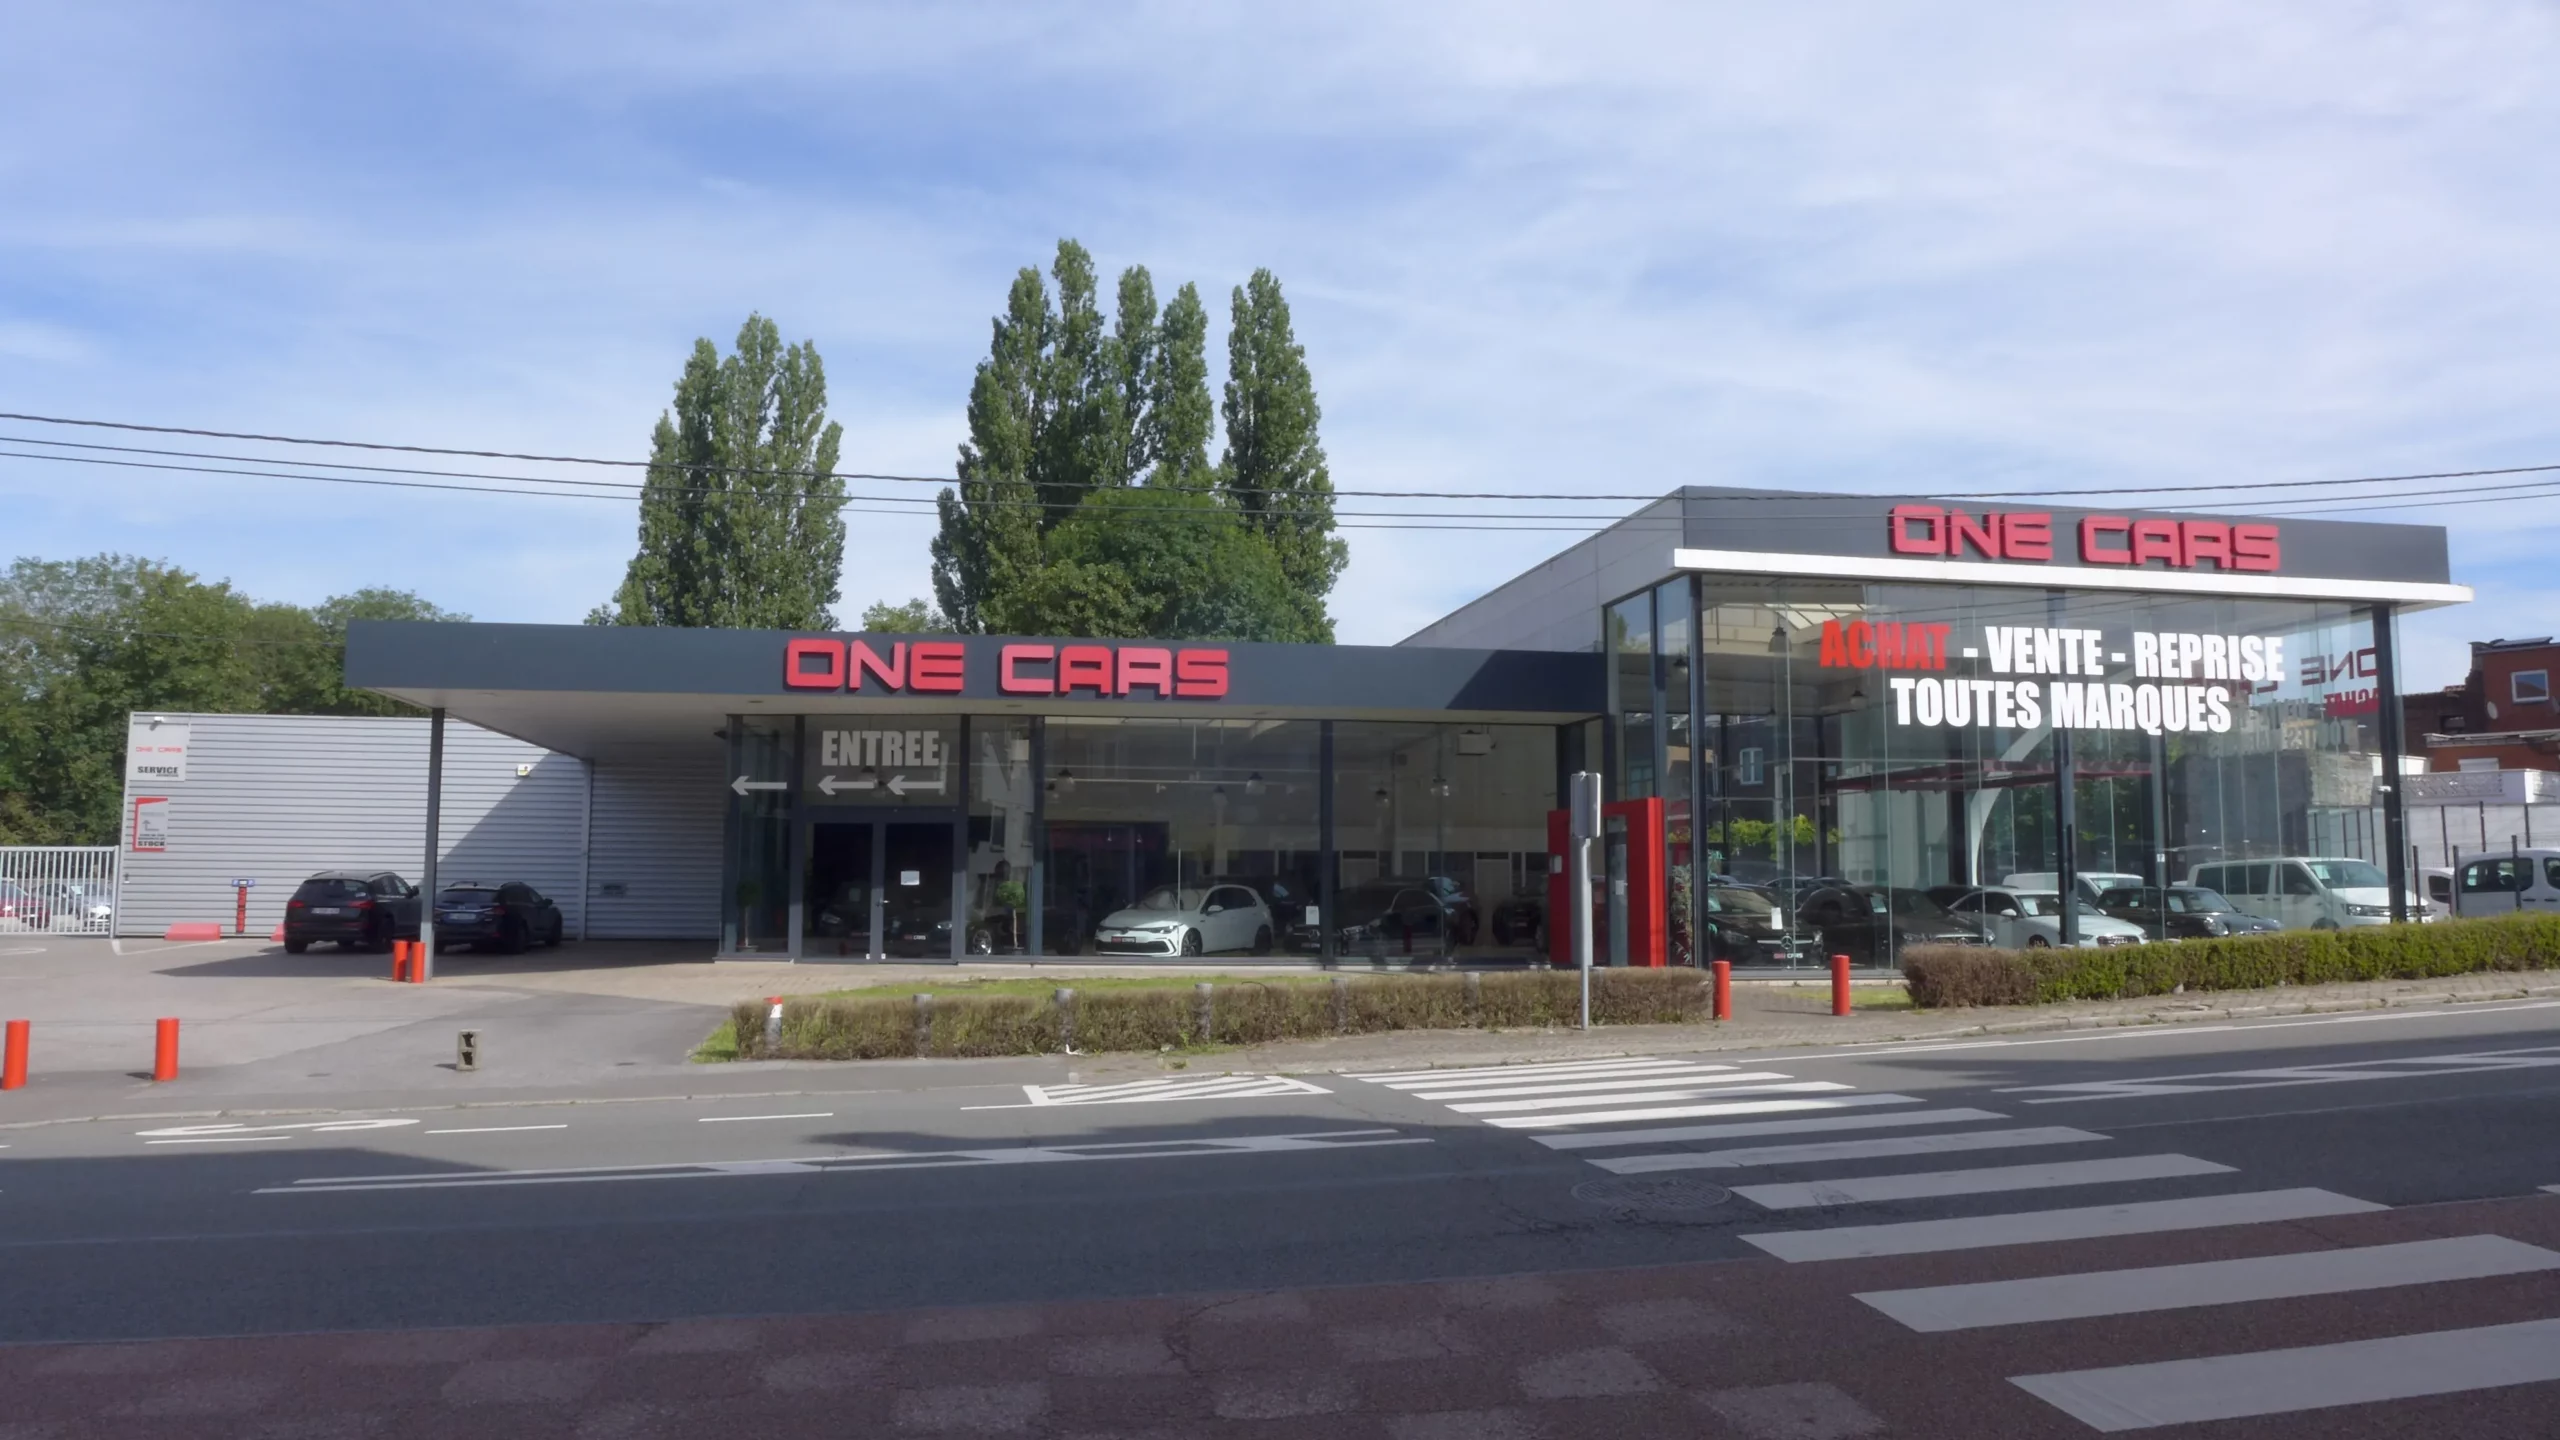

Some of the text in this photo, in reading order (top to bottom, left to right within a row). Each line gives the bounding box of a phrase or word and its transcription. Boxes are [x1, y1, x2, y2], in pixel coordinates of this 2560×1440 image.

[1889, 504, 2281, 571] ONE CARS
[784, 638, 1229, 698] ONE CARS
[1820, 620, 1951, 671] ACHAT
[1985, 626, 2104, 676] VENTE
[2133, 631, 2285, 682] REPRISE
[1890, 677, 2042, 729] TOUTES
[2050, 681, 2232, 736] MARQUES
[137, 766, 178, 774] SERVICE
[822, 731, 940, 766] ENTREE
